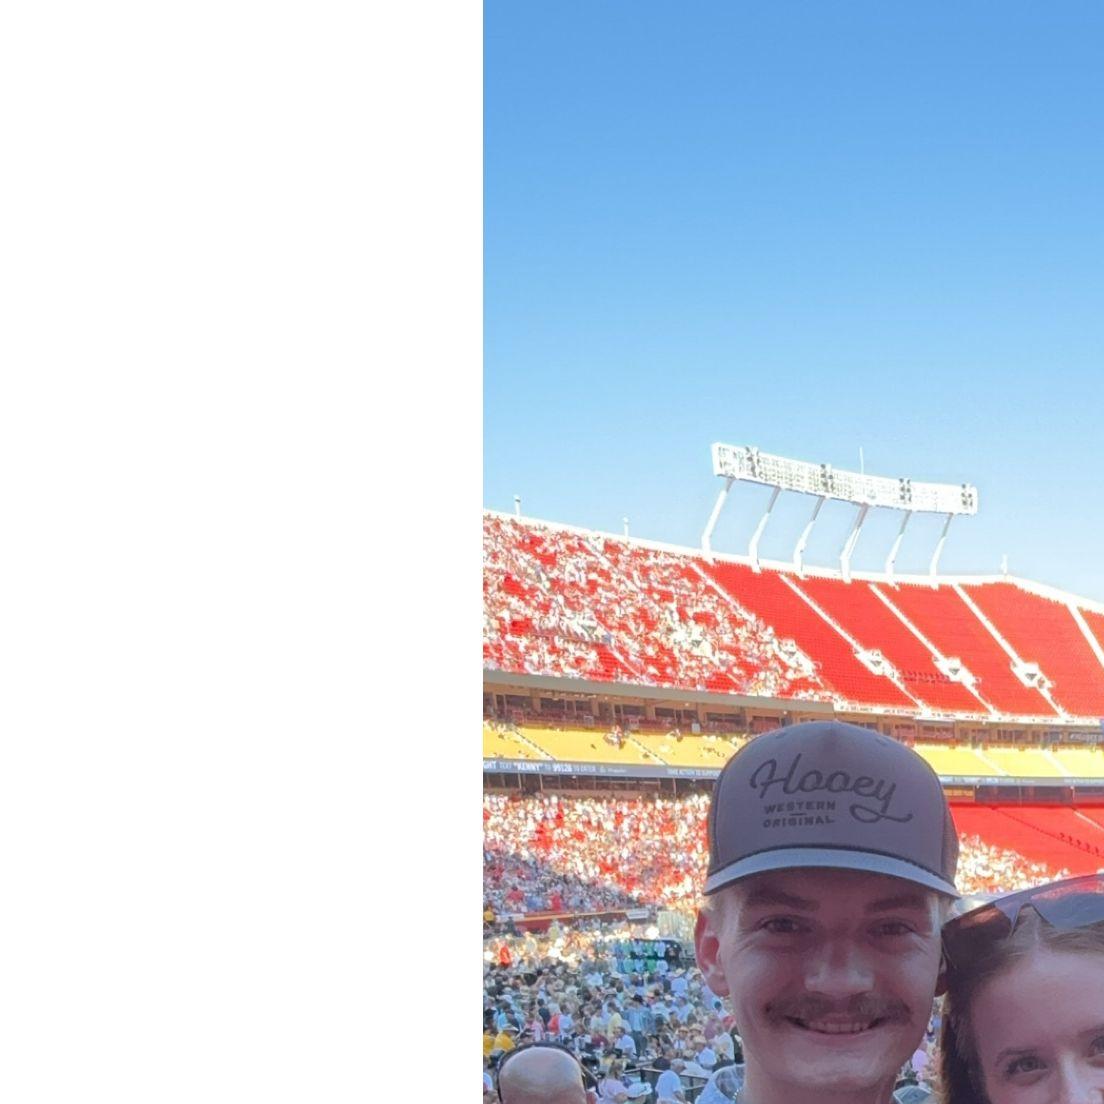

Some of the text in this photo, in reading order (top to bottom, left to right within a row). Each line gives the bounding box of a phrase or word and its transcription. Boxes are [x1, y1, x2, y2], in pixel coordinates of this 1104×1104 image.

[750, 753, 913, 823] Hooey
[764, 800, 836, 814] WESTERN
[763, 815, 835, 828] ORIGINAL
